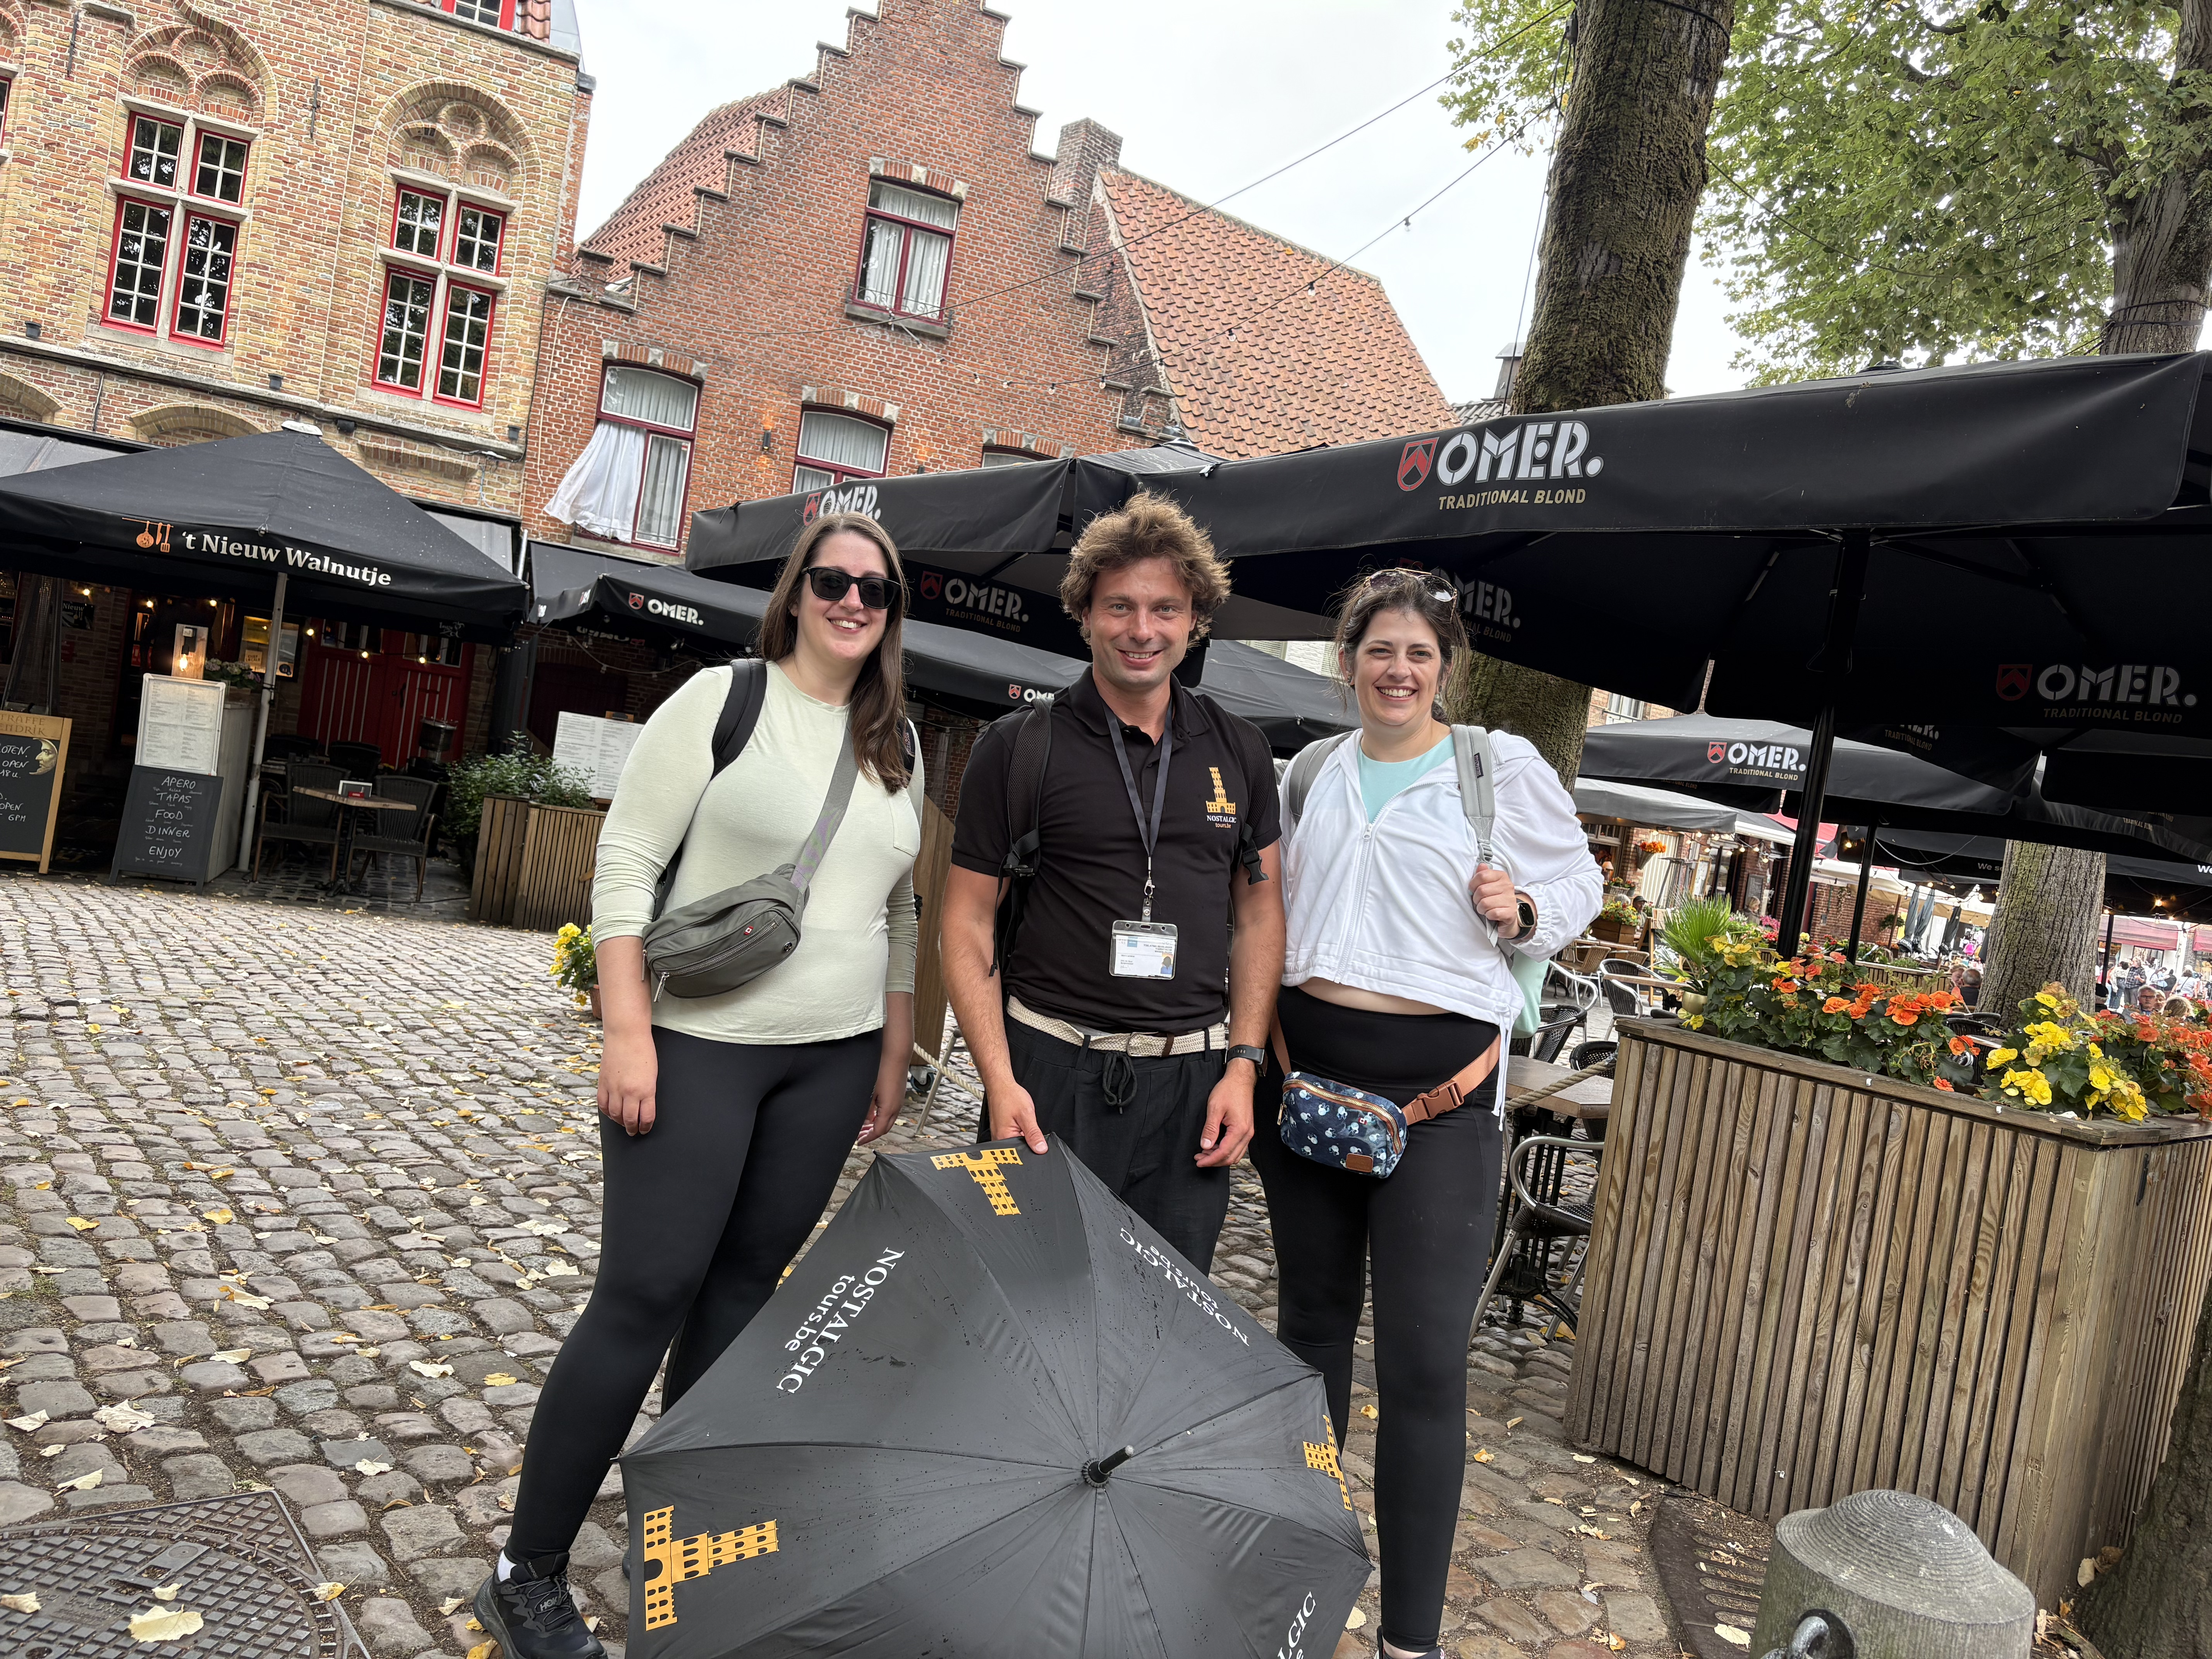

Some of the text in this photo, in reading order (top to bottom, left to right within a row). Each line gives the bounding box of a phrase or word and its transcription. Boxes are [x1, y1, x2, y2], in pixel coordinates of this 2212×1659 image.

[1436, 421, 1604, 486] OMER.
[819, 485, 881, 520] OMER.
[1439, 489, 1586, 510] TRADITIONAL BLOND
[201, 534, 281, 563] Nieuw
[285, 547, 392, 586] Walnutje
[647, 599, 704, 625] OMER.
[945, 578, 1029, 622] OMER.
[946, 608, 1020, 632] TRADITIONAL BLOND
[1484, 626, 1511, 642] BLOND
[2037, 664, 2198, 708] OMER.
[2044, 708, 2182, 723] TRADITIONAL BLOND
[0, 743, 31, 757] OTEN.
[1728, 742, 1806, 771] OMER.
[2, 760, 29, 768] OPEN
[1729, 768, 1798, 781] TRADITIONAL BLOND
[161, 776, 196, 789] APERO
[156, 792, 191, 803] TAPAS
[155, 809, 183, 820] FOOD
[145, 826, 190, 838] DINNER
[149, 846, 182, 859] ENJOY
[1120, 1228, 1249, 1346] NOSTALGIC
[1150, 1245, 1218, 1309] tours.be
[776, 1247, 905, 1393] NOSTALGIC
[785, 1275, 855, 1351] tours.be
